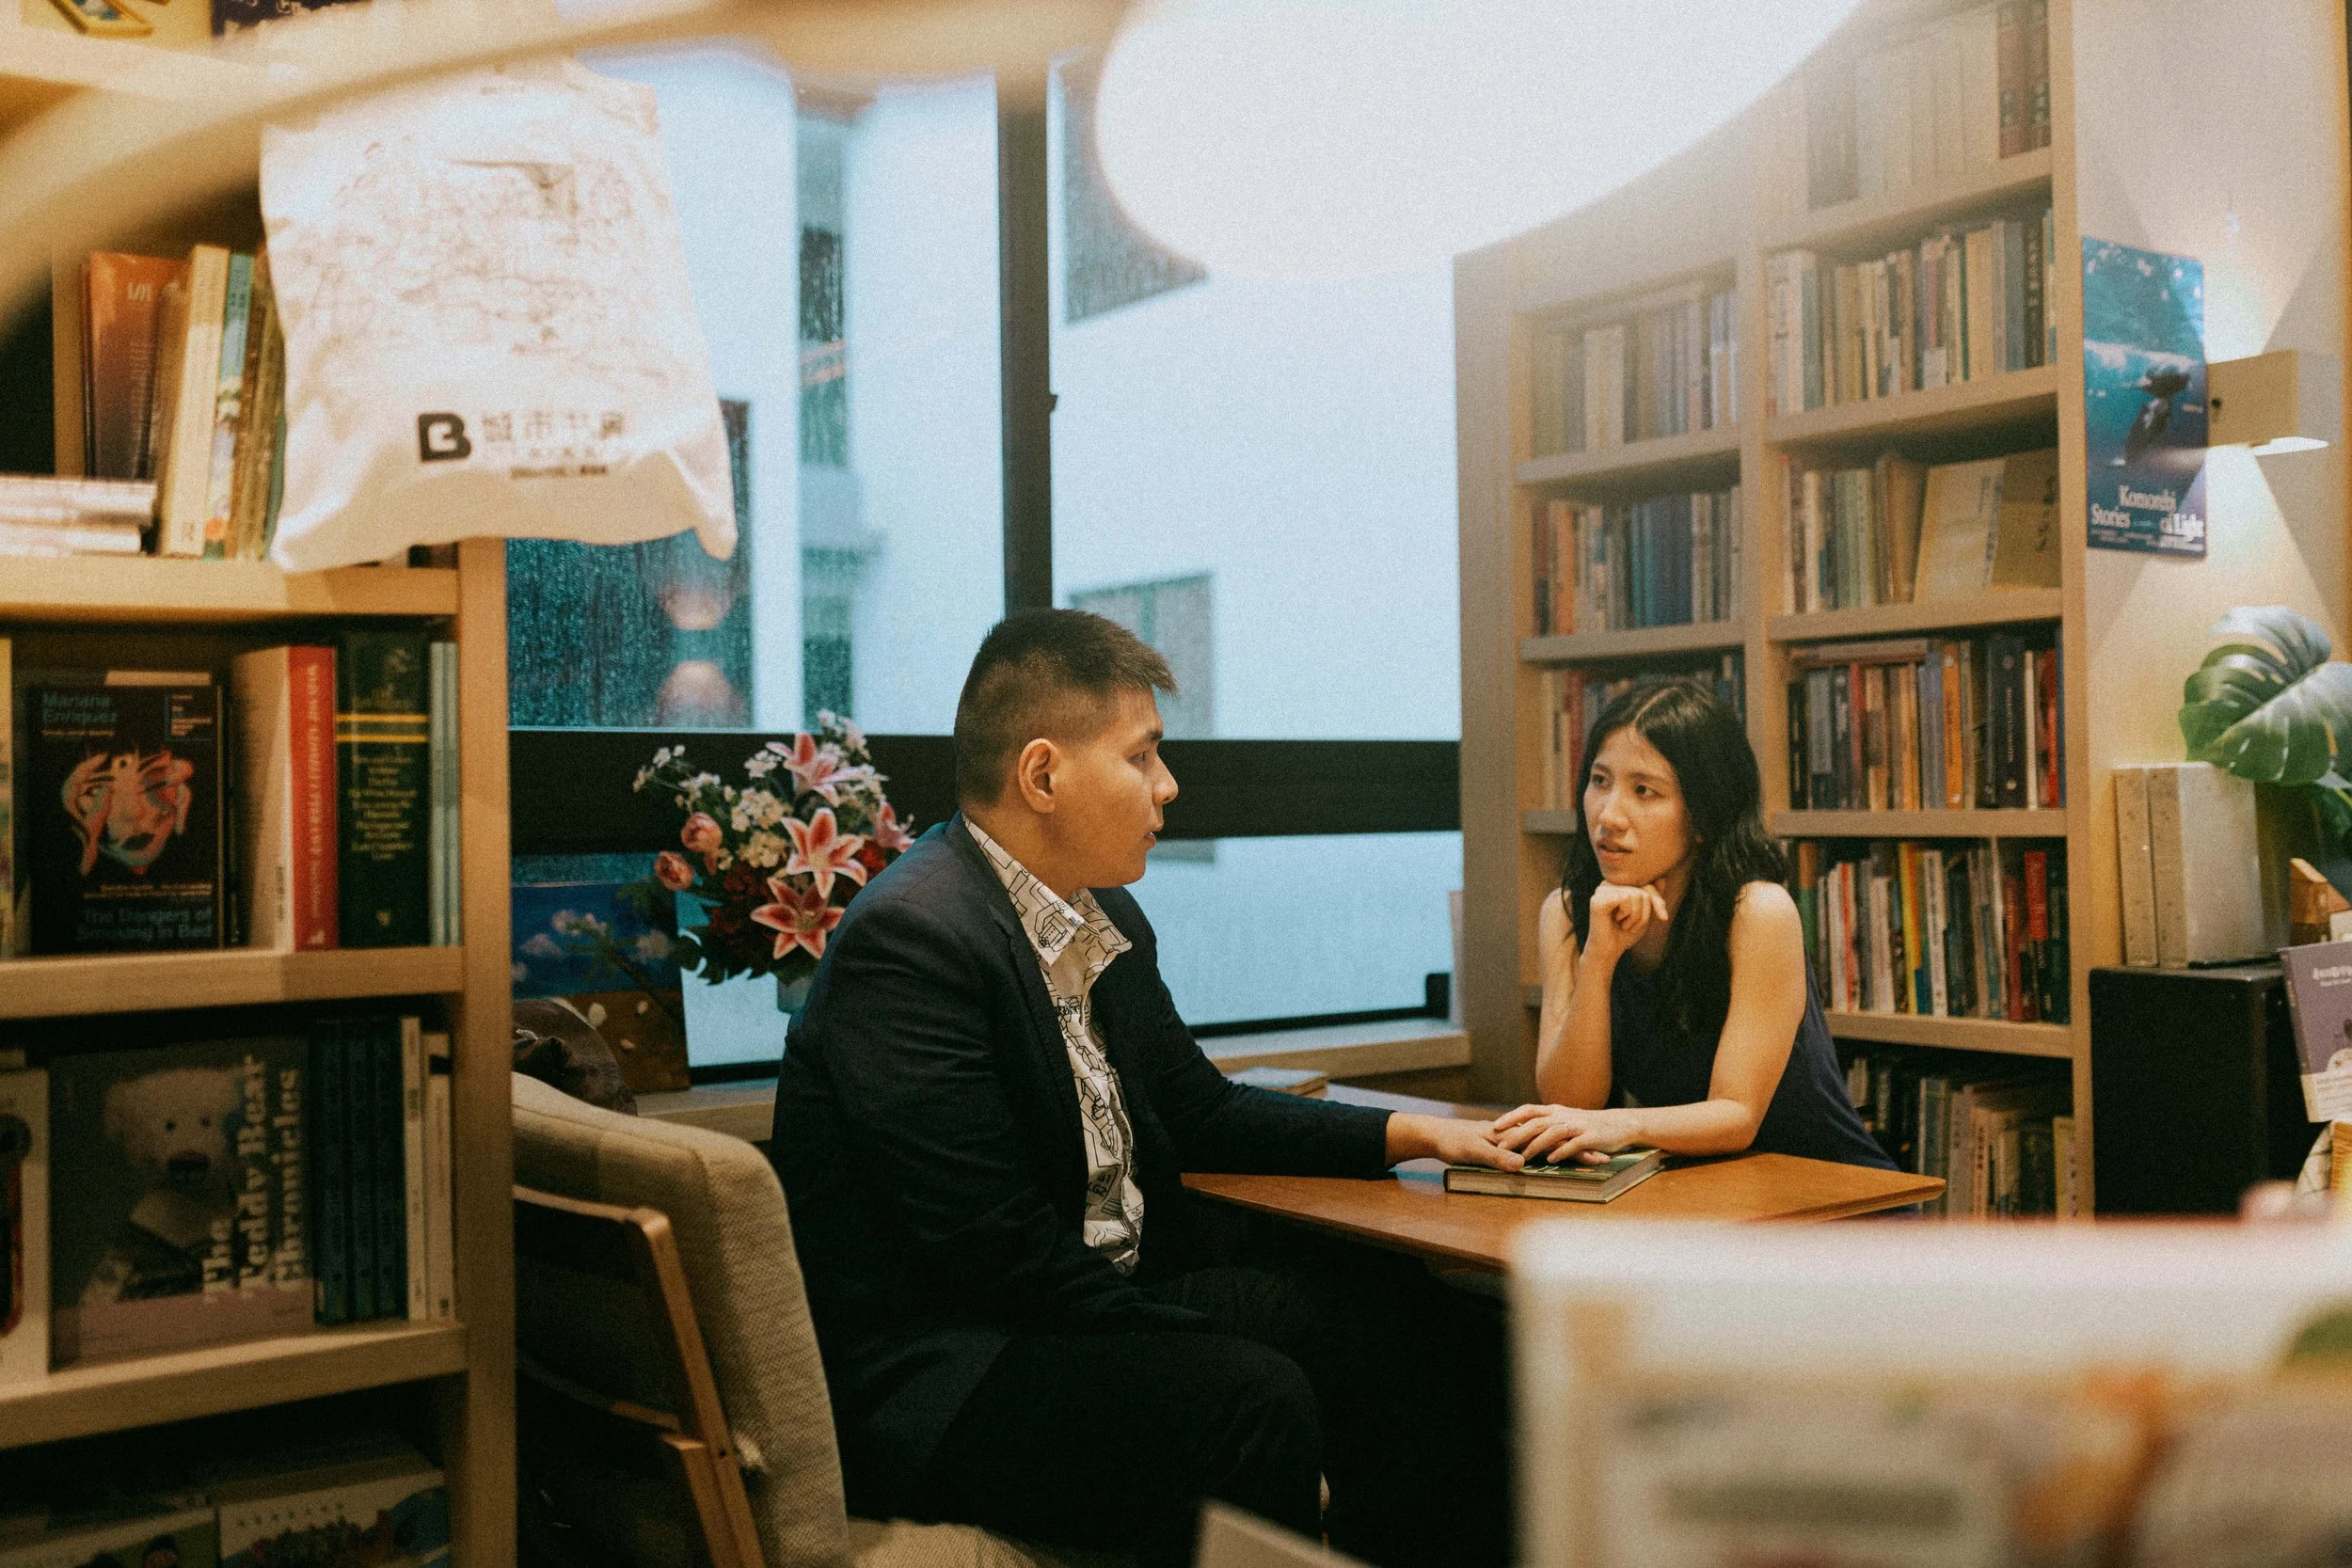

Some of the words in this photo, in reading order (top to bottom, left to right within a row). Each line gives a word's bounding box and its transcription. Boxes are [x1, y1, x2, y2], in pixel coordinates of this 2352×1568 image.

[2091, 503, 2131, 529] Stories
[42, 691, 112, 708] Mariana
[84, 909, 114, 924] The
[195, 906, 213, 923] of
[178, 924, 213, 939] Bed
[236, 1054, 269, 1159] Bear
[270, 1069, 302, 1292] Chronicles
[236, 1165, 274, 1299] Teddy
[201, 1217, 232, 1304] The
